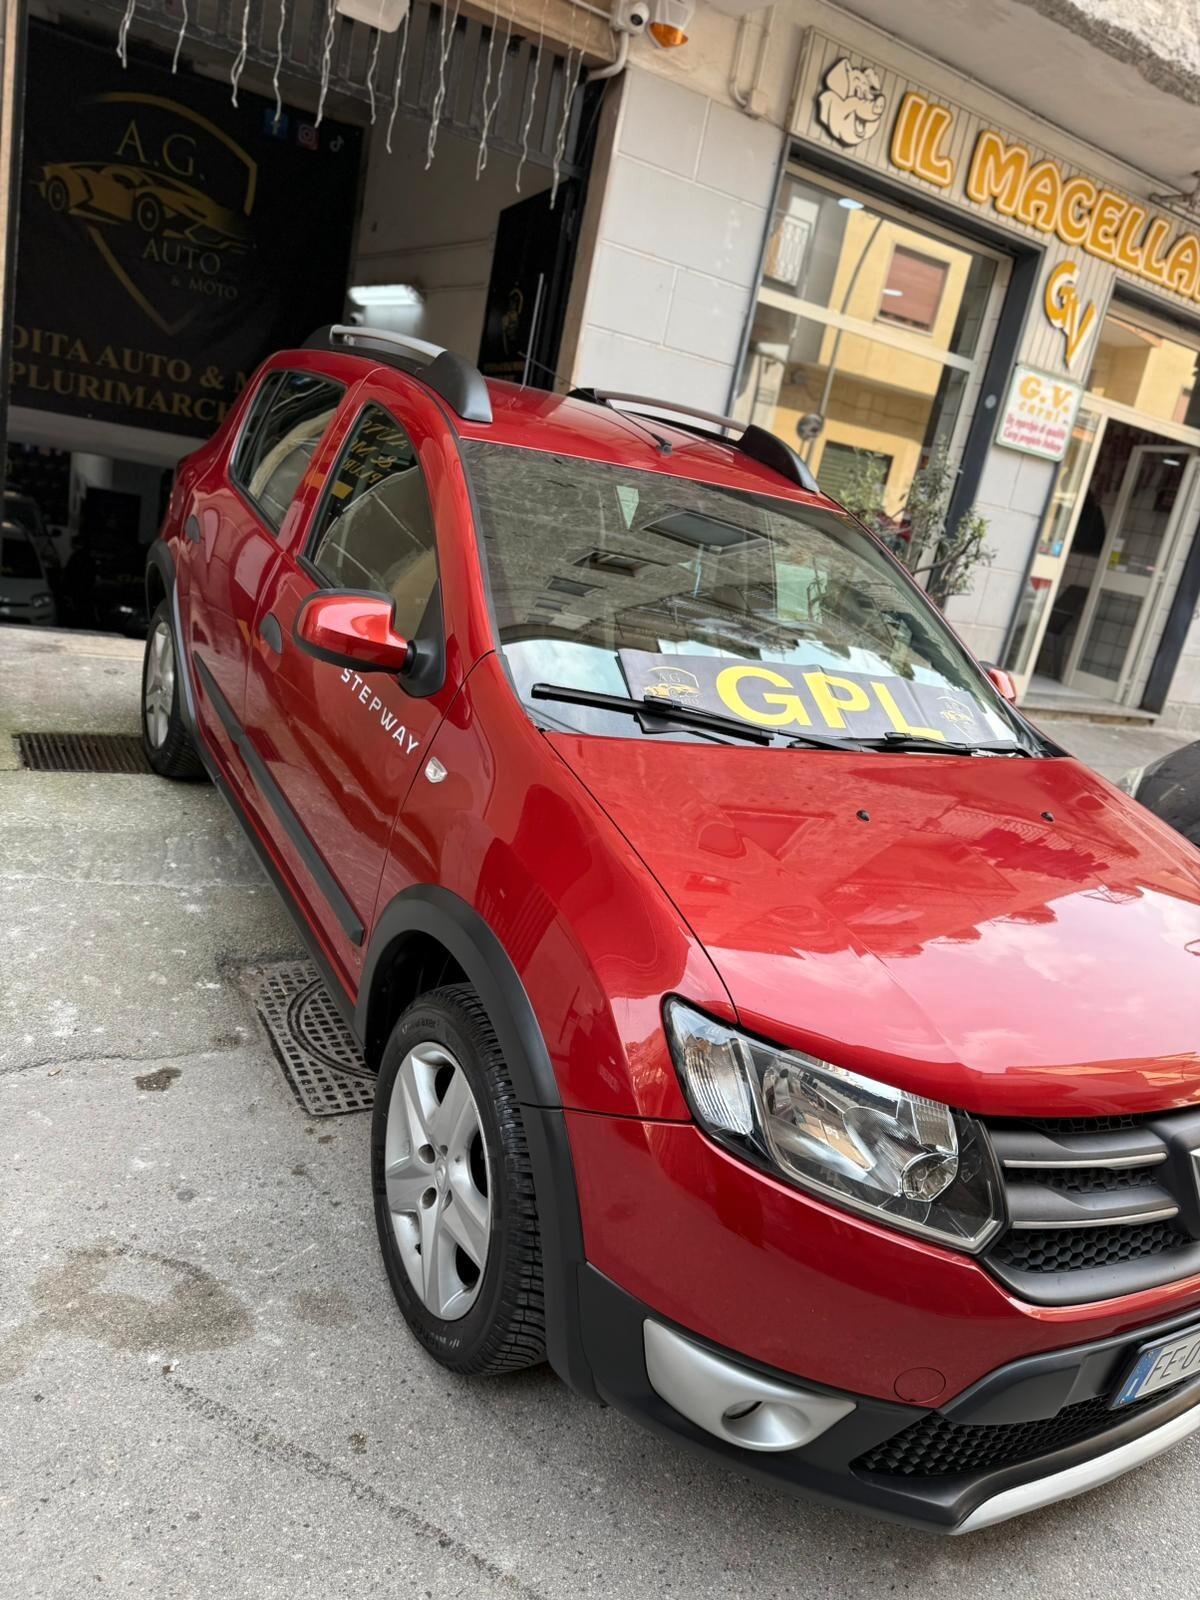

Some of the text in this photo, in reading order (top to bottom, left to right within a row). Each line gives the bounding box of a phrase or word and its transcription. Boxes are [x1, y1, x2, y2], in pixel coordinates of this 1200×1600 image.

[115, 119, 206, 181] A.G.
[890, 91, 1200, 303] IL MACELLA
[142, 239, 221, 276] AUTO
[171, 277, 239, 299] & MOTO
[96, 343, 193, 384] AUTO
[199, 365, 225, 389] &
[1019, 375, 1073, 413] G.V.
[340, 667, 420, 755] STEPWAY
[715, 665, 946, 741] GPL
